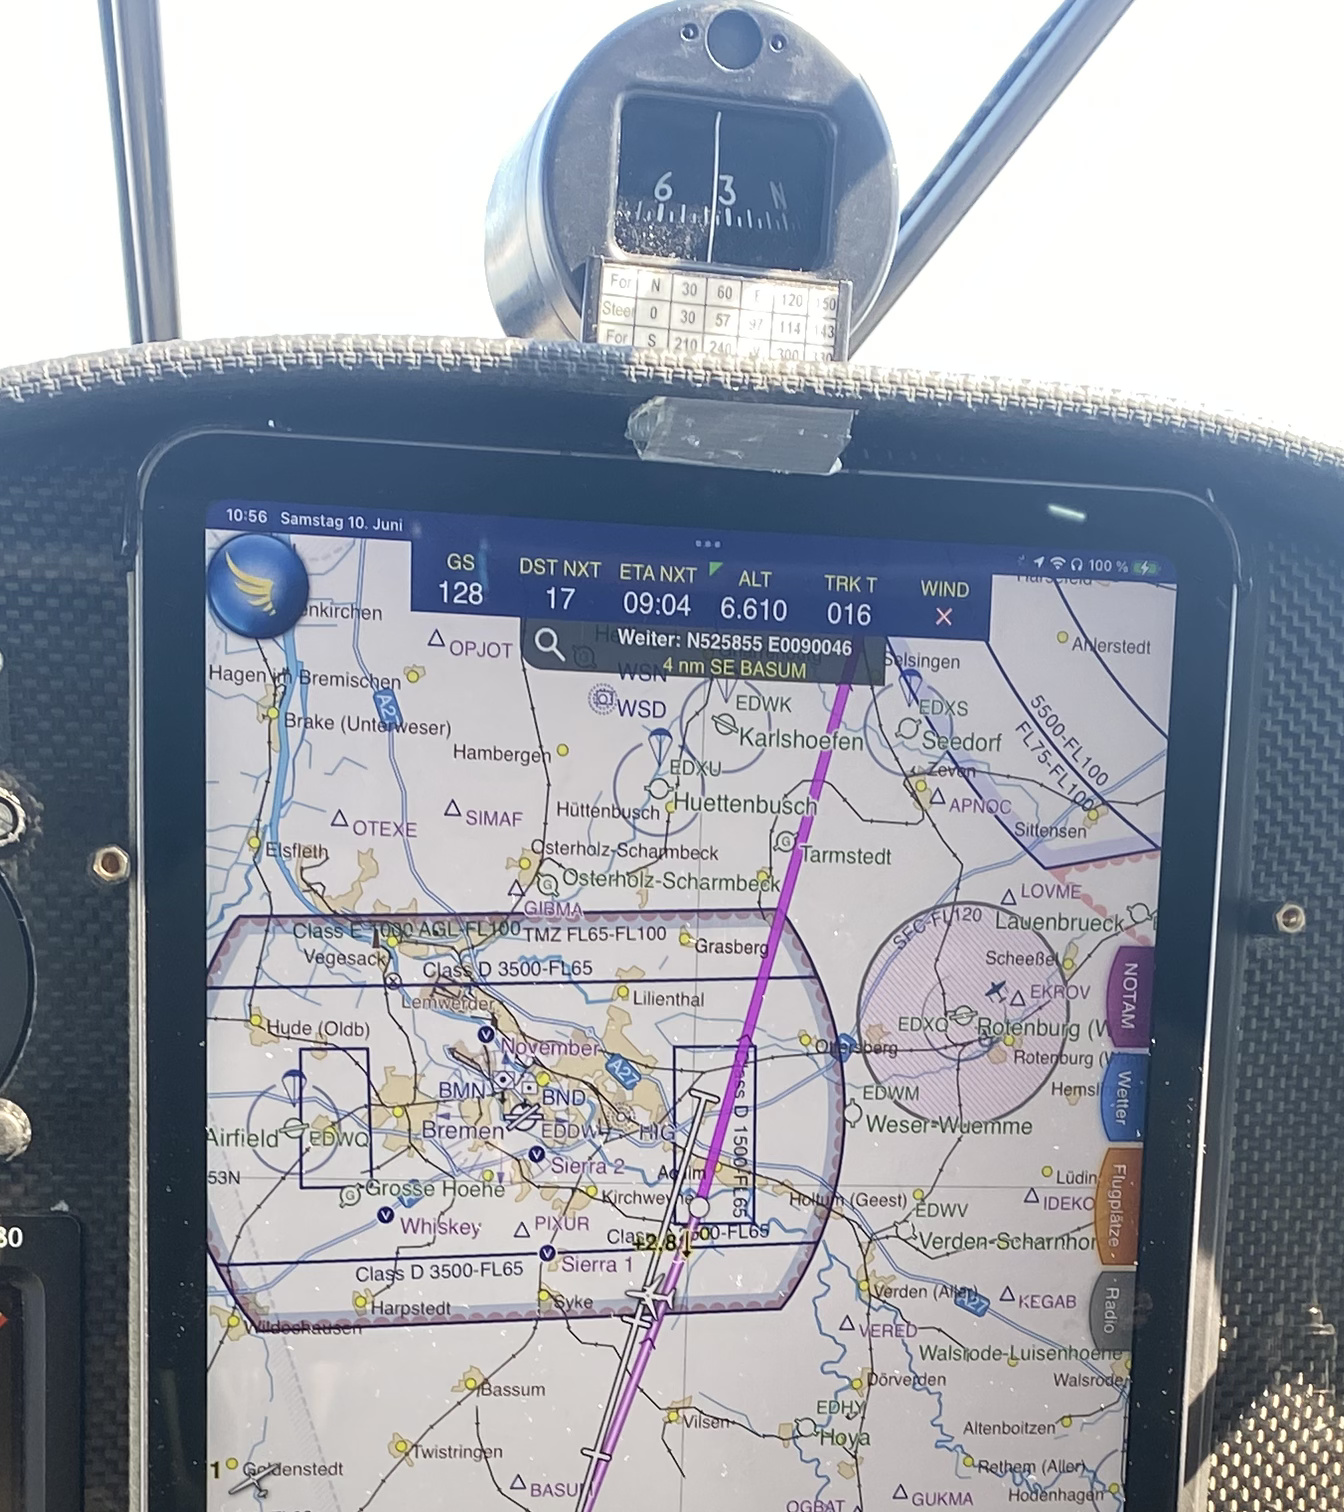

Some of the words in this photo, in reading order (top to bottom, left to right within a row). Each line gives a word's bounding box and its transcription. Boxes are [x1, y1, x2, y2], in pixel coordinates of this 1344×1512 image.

[654, 172, 673, 202] 6
[718, 175, 737, 206] 3
[650, 278, 661, 292] N
[681, 282, 697, 297] 30
[717, 286, 733, 300] 60
[680, 311, 695, 325] 30
[715, 312, 730, 328] 57
[227, 509, 268, 523] 10:56
[280, 512, 343, 529] Samstag
[348, 517, 367, 530] 10.
[373, 518, 403, 531] Juni
[447, 554, 474, 570] GS
[520, 558, 557, 575] DST
[563, 561, 601, 578] NXT
[1089, 559, 1112, 572] 100
[620, 564, 655, 581] ETA
[660, 567, 697, 583] NXT
[739, 571, 772, 587] ALT
[439, 581, 483, 604] 128
[825, 575, 861, 591] TRK
[866, 577, 877, 593] T
[921, 580, 969, 598] WIND
[547, 588, 575, 609] 17
[624, 592, 691, 616] 09:04
[721, 598, 787, 621] 6.610
[828, 603, 871, 625] 016
[450, 641, 513, 658] OPJOT
[618, 628, 681, 648] Weiter:
[687, 631, 763, 652] N525855
[768, 637, 853, 656] E0090046
[209, 664, 266, 684] Hagen
[299, 670, 401, 690] Bremischen
[663, 656, 673, 672] 4
[678, 661, 704, 674] nm
[710, 660, 735, 676] SE
[740, 661, 807, 679] BASUM
[618, 701, 666, 718] WSD
[740, 729, 863, 751] Karlshoefen
[923, 730, 1002, 752] Seedorf
[996, 912, 1124, 932] Lauenbrueck
[526, 926, 562, 943] TMZ
[567, 926, 666, 943] FL65-FL100
[633, 991, 705, 1007] Lilienthal
[1122, 962, 1138, 1029] NOTAM
[267, 1021, 312, 1036] Hude
[319, 1021, 370, 1038] (Oldb)
[1114, 1071, 1132, 1126] Wetter
[422, 1121, 504, 1140] Bremen
[867, 1116, 1032, 1135] Weser-Wuemme
[1109, 1163, 1126, 1248] Flugplätze
[401, 1218, 481, 1238] Whiskey
[1104, 1287, 1119, 1334] Radio
[481, 1383, 545, 1397] Bassum
[964, 1421, 1055, 1435] Altenboitzen
[413, 1444, 503, 1462] Twistringen
